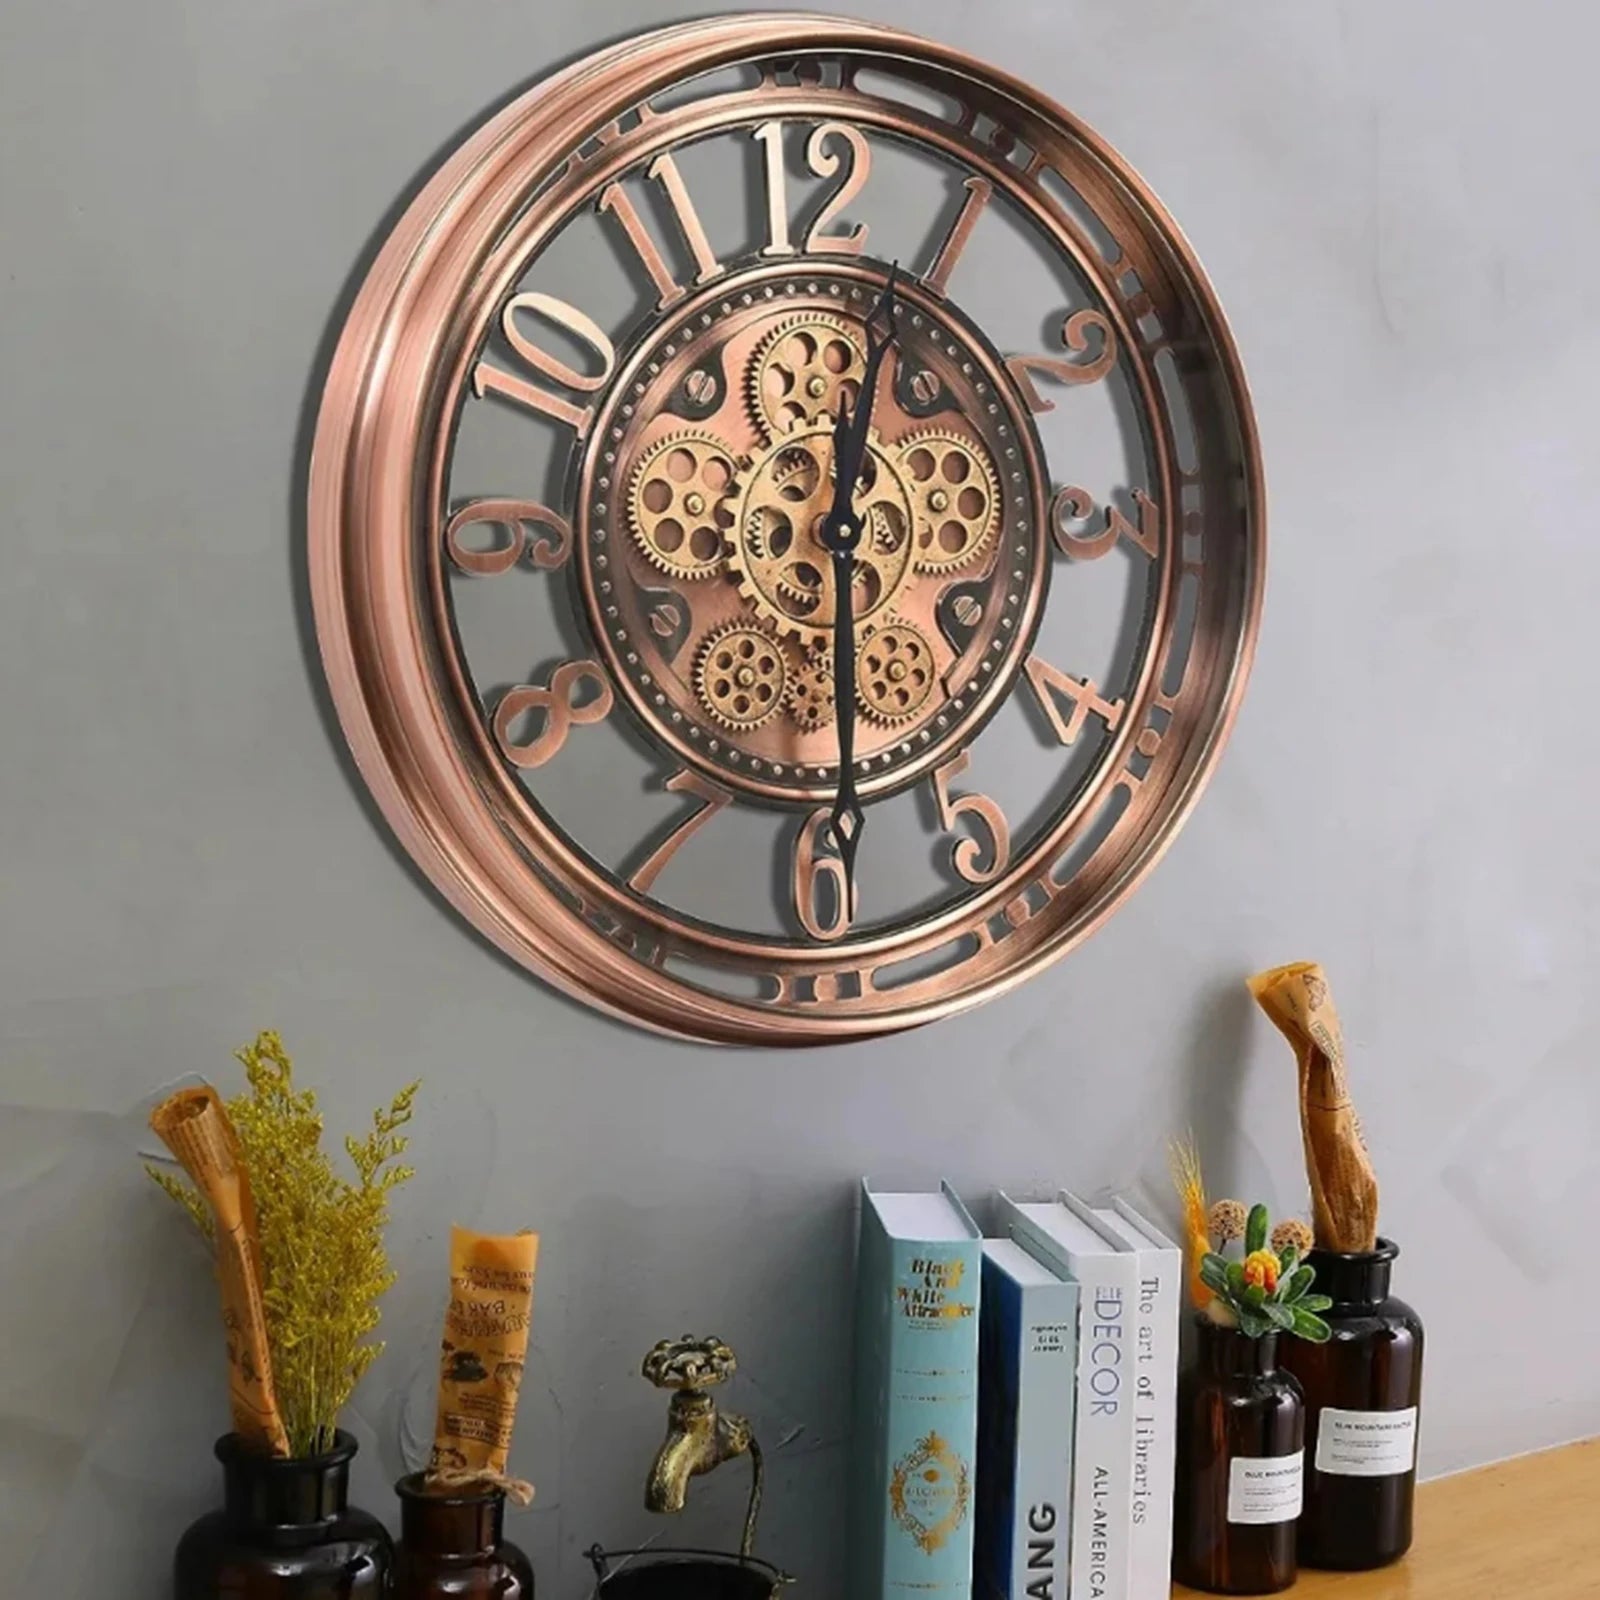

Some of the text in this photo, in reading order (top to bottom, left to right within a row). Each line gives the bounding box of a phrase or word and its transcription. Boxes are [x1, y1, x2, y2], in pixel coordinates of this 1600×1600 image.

[599, 152, 725, 310] 11
[753, 122, 871, 255] 12
[919, 176, 992, 299] 1
[474, 291, 615, 440] 10
[1006, 308, 1118, 414] 2
[446, 498, 571, 576] 9
[1052, 484, 1159, 560] 3
[493, 659, 613, 769] 8
[1023, 653, 1125, 747] 4
[627, 768, 734, 896] 7
[793, 806, 859, 941] 6
[932, 748, 1010, 884] 5
[1091, 1300, 1122, 1416] DECOR
[1132, 1277, 1159, 1525] The art of libraries
